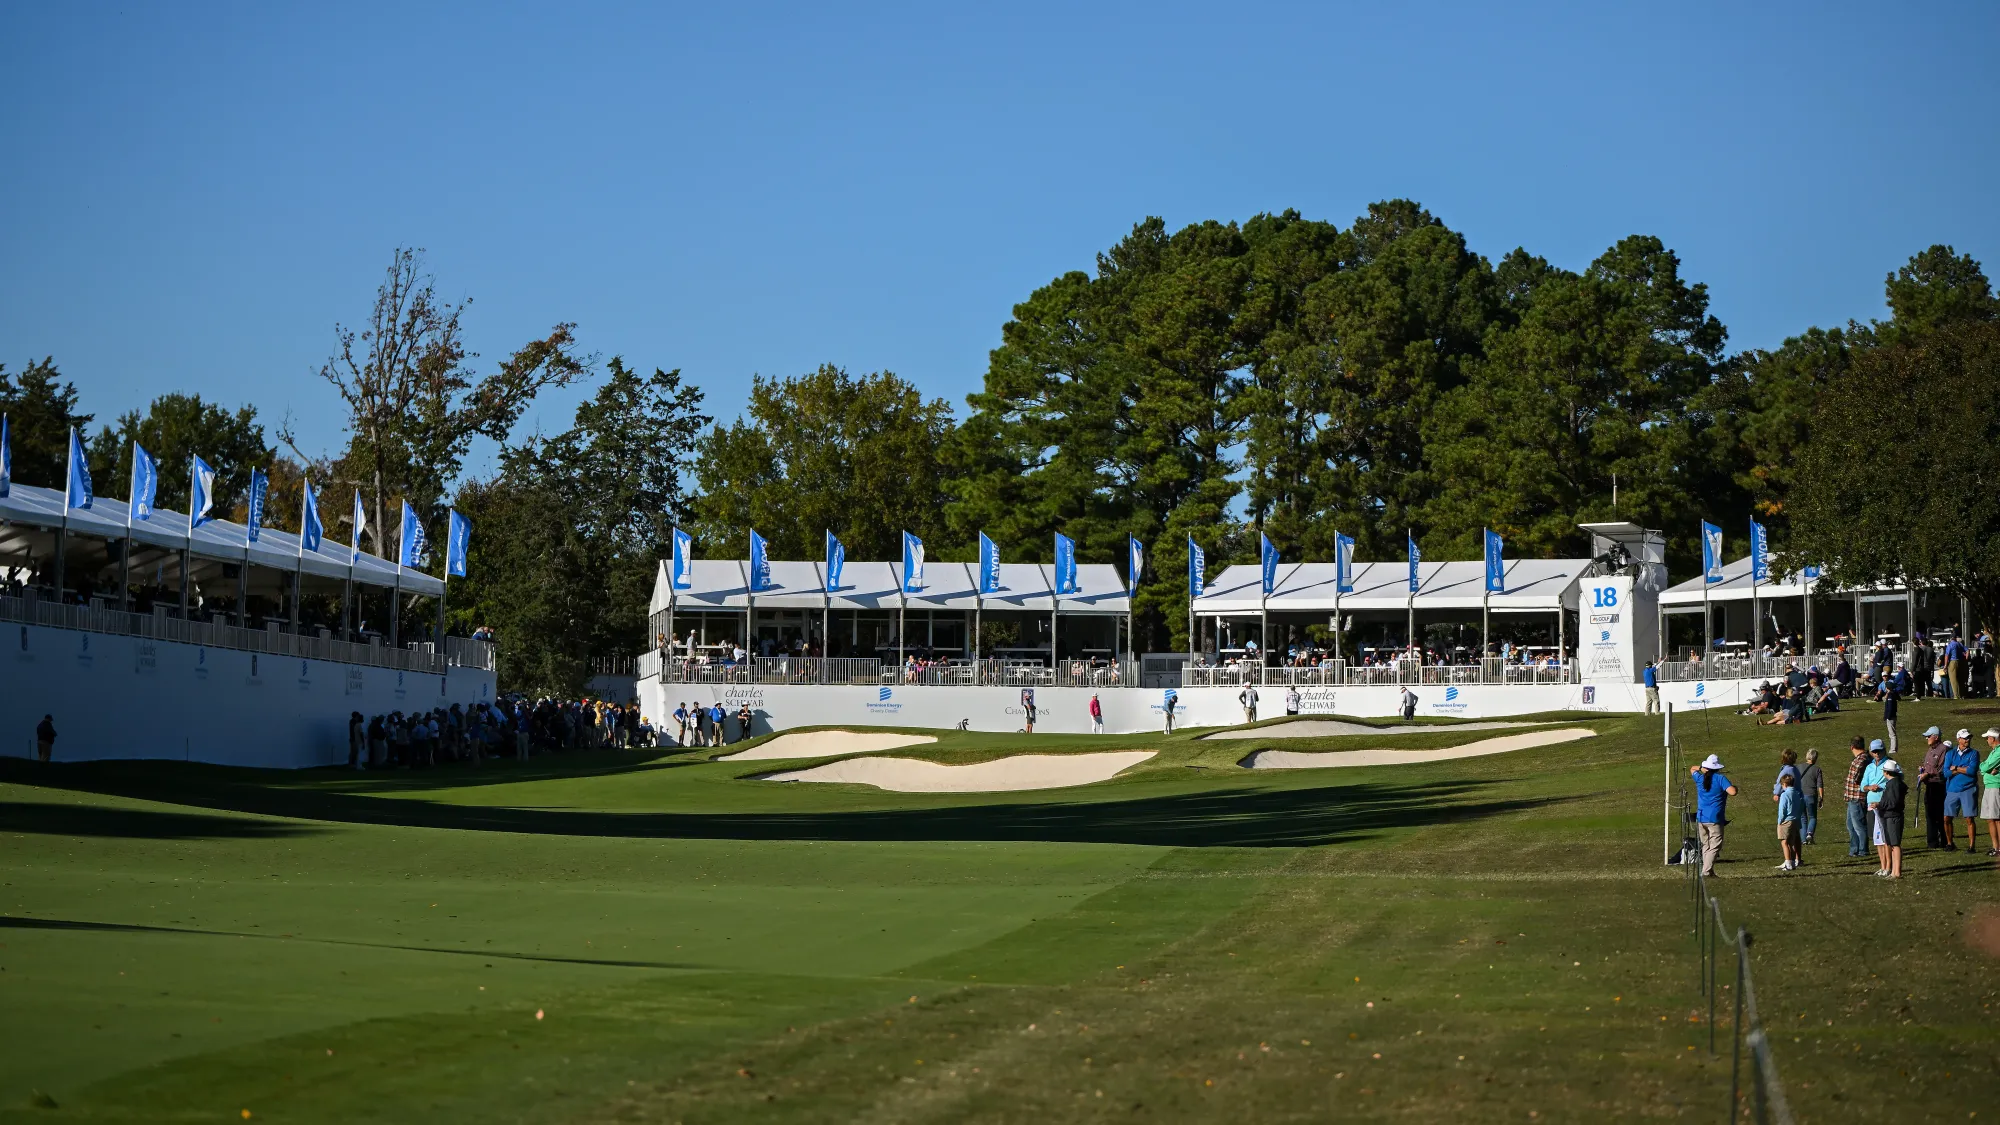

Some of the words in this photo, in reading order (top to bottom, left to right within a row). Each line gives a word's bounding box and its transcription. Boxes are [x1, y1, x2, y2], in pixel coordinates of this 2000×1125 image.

[141, 473, 151, 501] Dominion
[250, 477, 269, 539] PLAYOFFS
[1757, 523, 1767, 578] PLAYOFFS
[990, 543, 999, 590] PLAYOFF
[1593, 587, 1618, 608] 18
[725, 686, 764, 698] charles
[1299, 688, 1337, 700] charles
[1004, 706, 1050, 716] CHAMONS
[1298, 701, 1336, 709] SCHWAB
